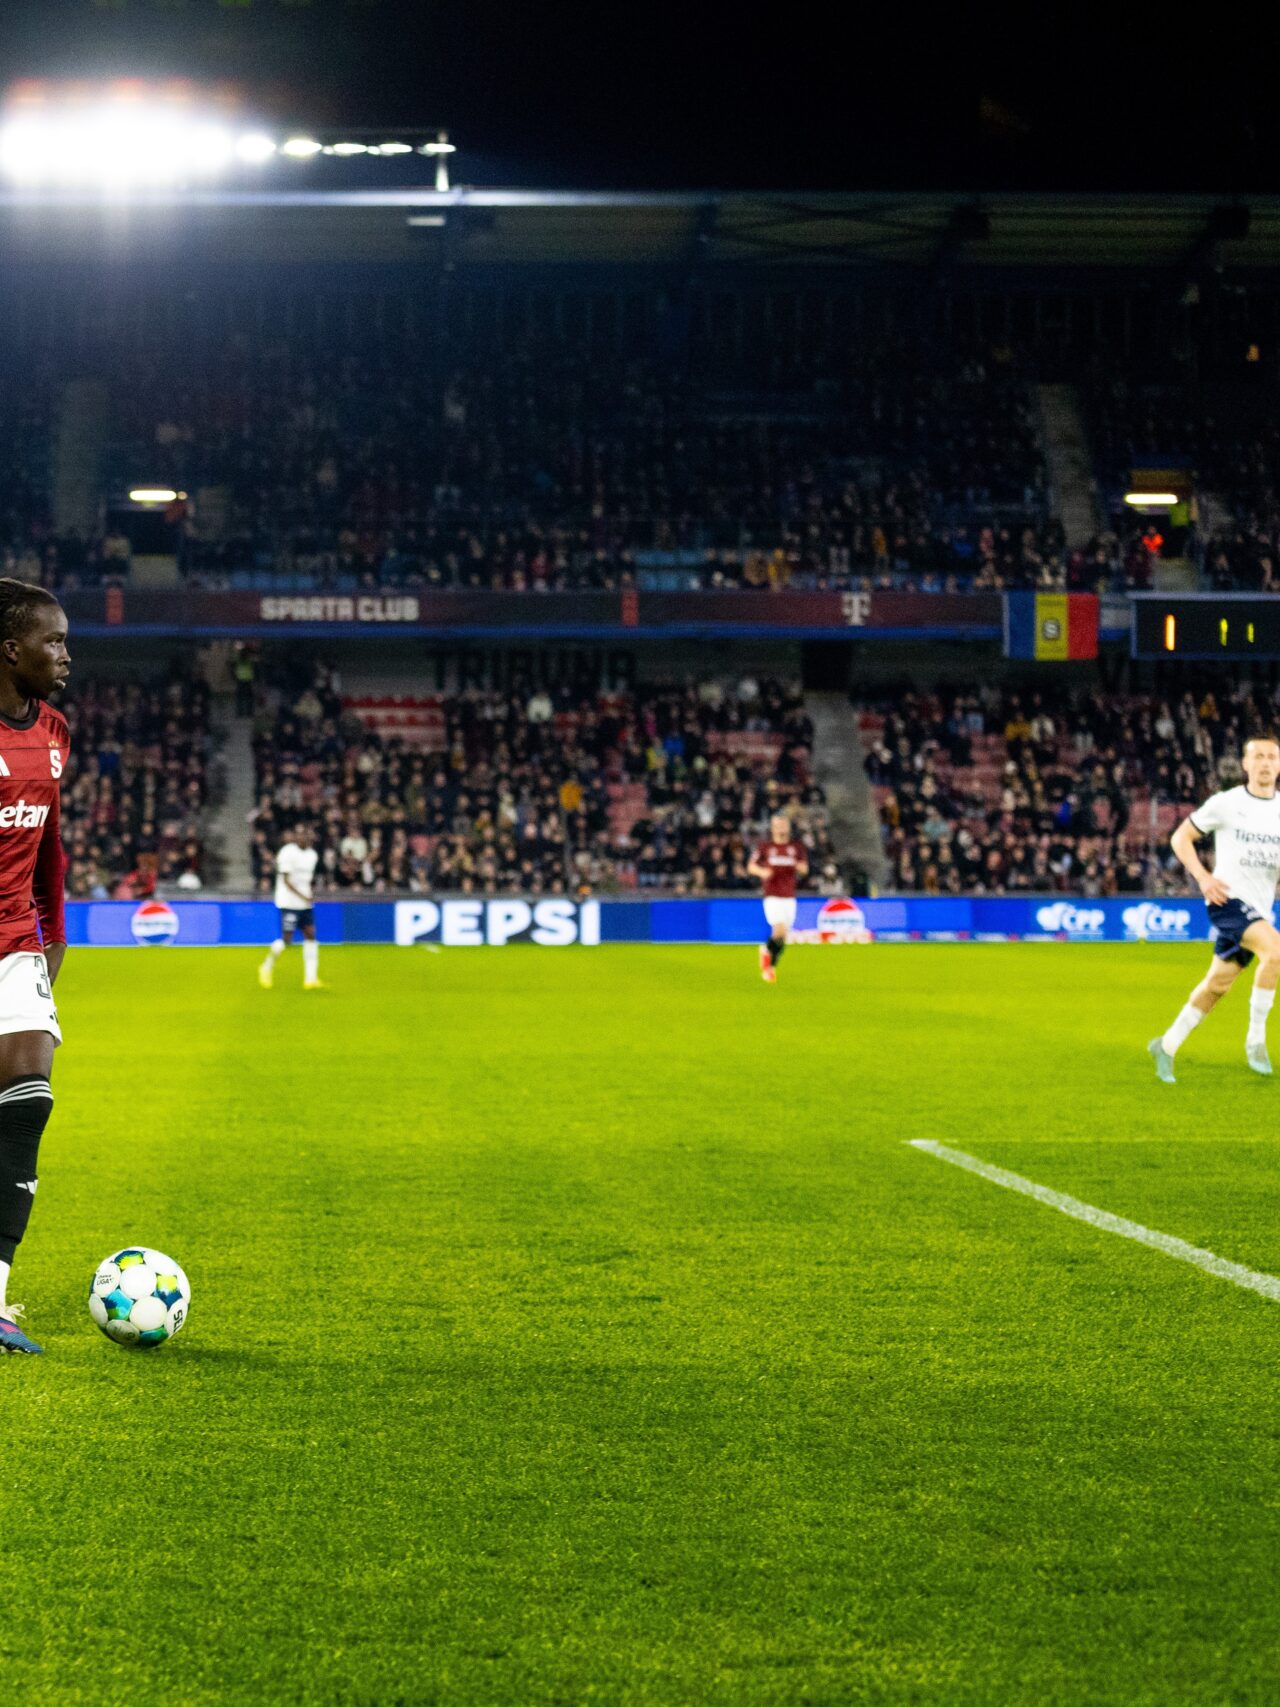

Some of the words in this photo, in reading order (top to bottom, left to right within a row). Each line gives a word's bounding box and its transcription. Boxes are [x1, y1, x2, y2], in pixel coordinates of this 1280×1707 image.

[260, 596, 353, 621] SPARTA
[358, 596, 419, 621] CLUB
[50, 749, 63, 779] S
[394, 899, 601, 946] PEPSI
